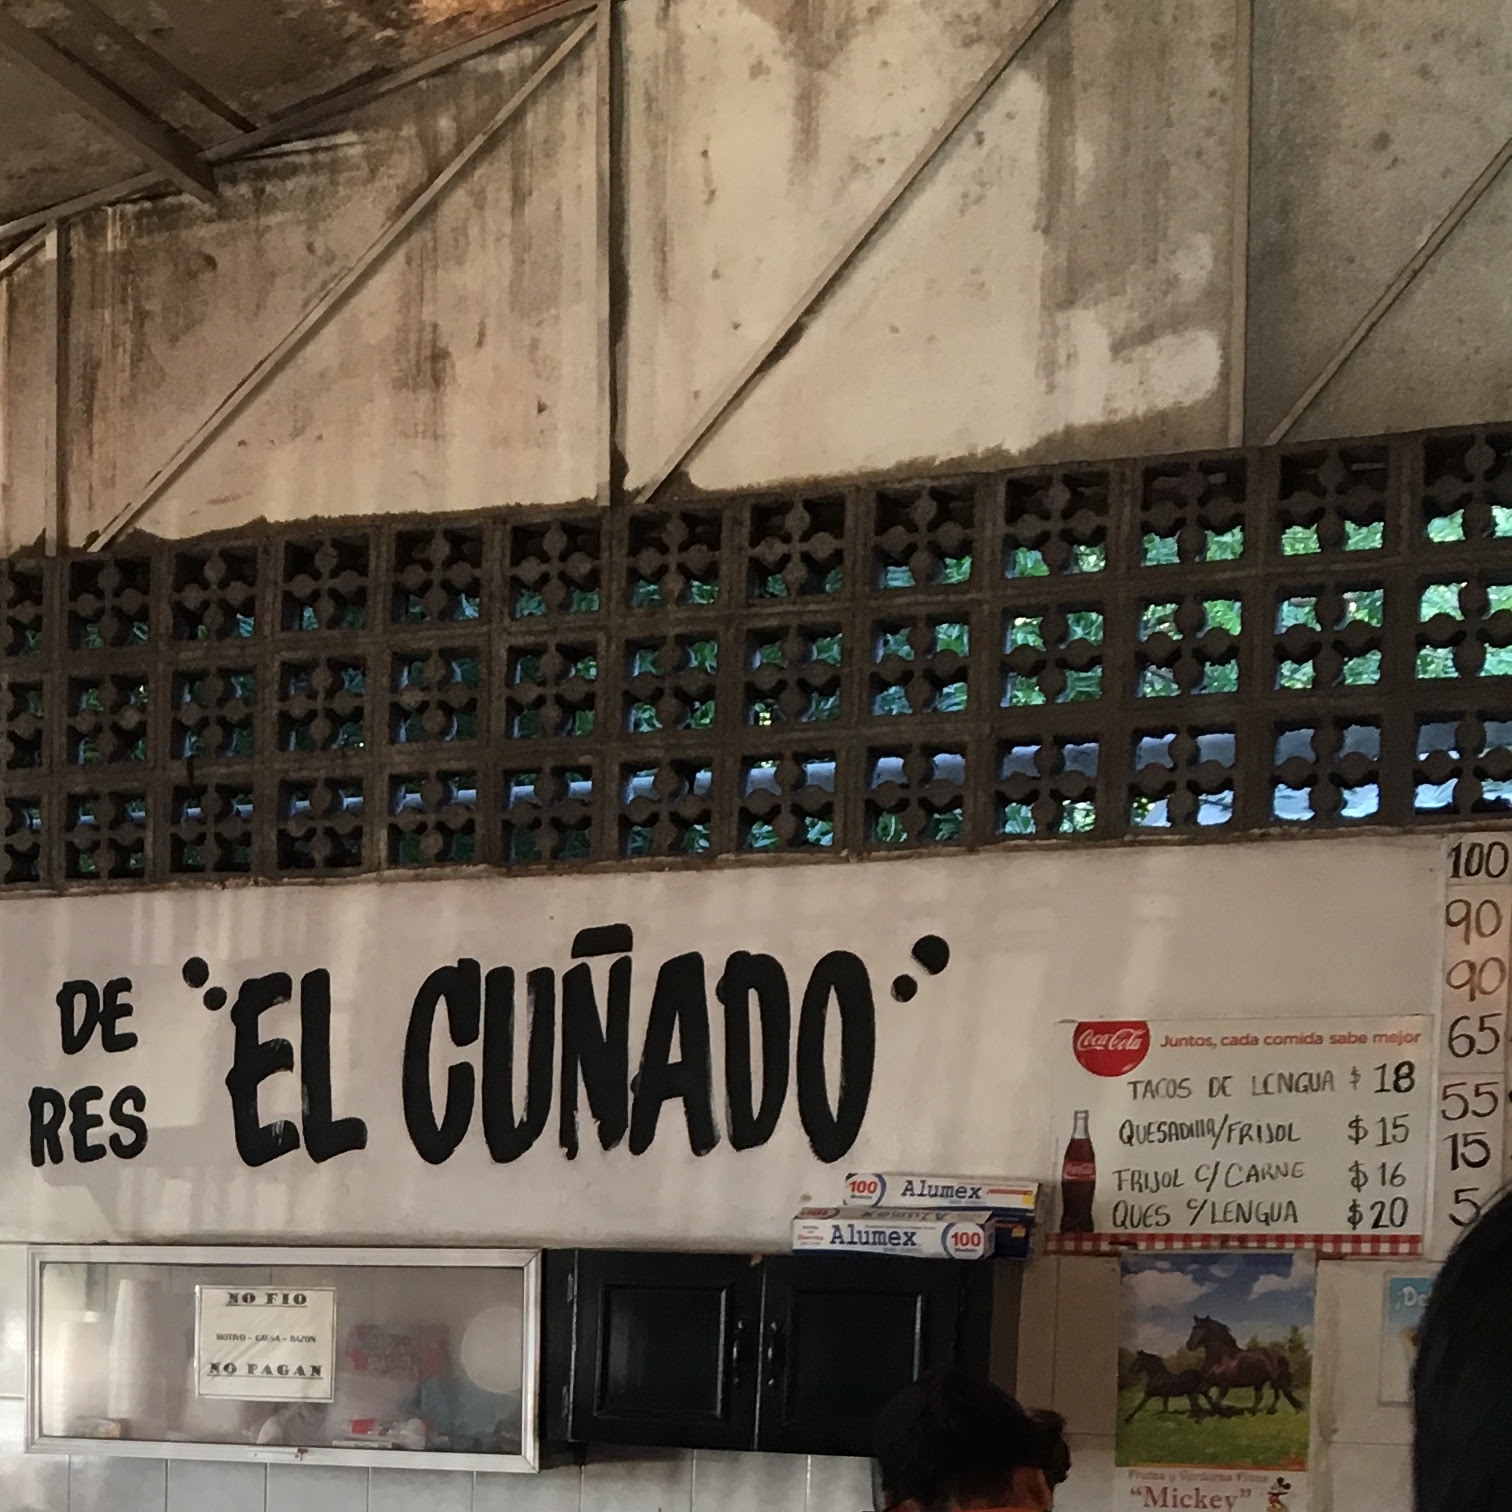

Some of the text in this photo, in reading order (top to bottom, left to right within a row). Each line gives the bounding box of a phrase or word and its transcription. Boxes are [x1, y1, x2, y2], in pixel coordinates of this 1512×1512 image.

[1446, 841, 1509, 879] 100
[1445, 898, 1503, 946] 90
[1445, 956, 1506, 1003] 90
[56, 977, 138, 1055] DE
[1159, 1031, 1422, 1049] Juntos, cada comida sabe mejor
[1448, 1013, 1503, 1058] 65
[1127, 1077, 1194, 1101] TACOS
[1208, 1075, 1233, 1098] DE
[1251, 1069, 1336, 1097] LENGUA
[1441, 1082, 1500, 1121] 55
[29, 1084, 148, 1167] RES
[1444, 1132, 1491, 1171] 15
[849, 1179, 983, 1200] 100 Alumex
[1112, 1167, 1185, 1194] FRIJOL
[1111, 1203, 1172, 1230] QUES
[829, 1223, 981, 1248] Alumex 100
[227, 1292, 307, 1305] NO FIO
[209, 1362, 322, 1376] NO PAGAN
